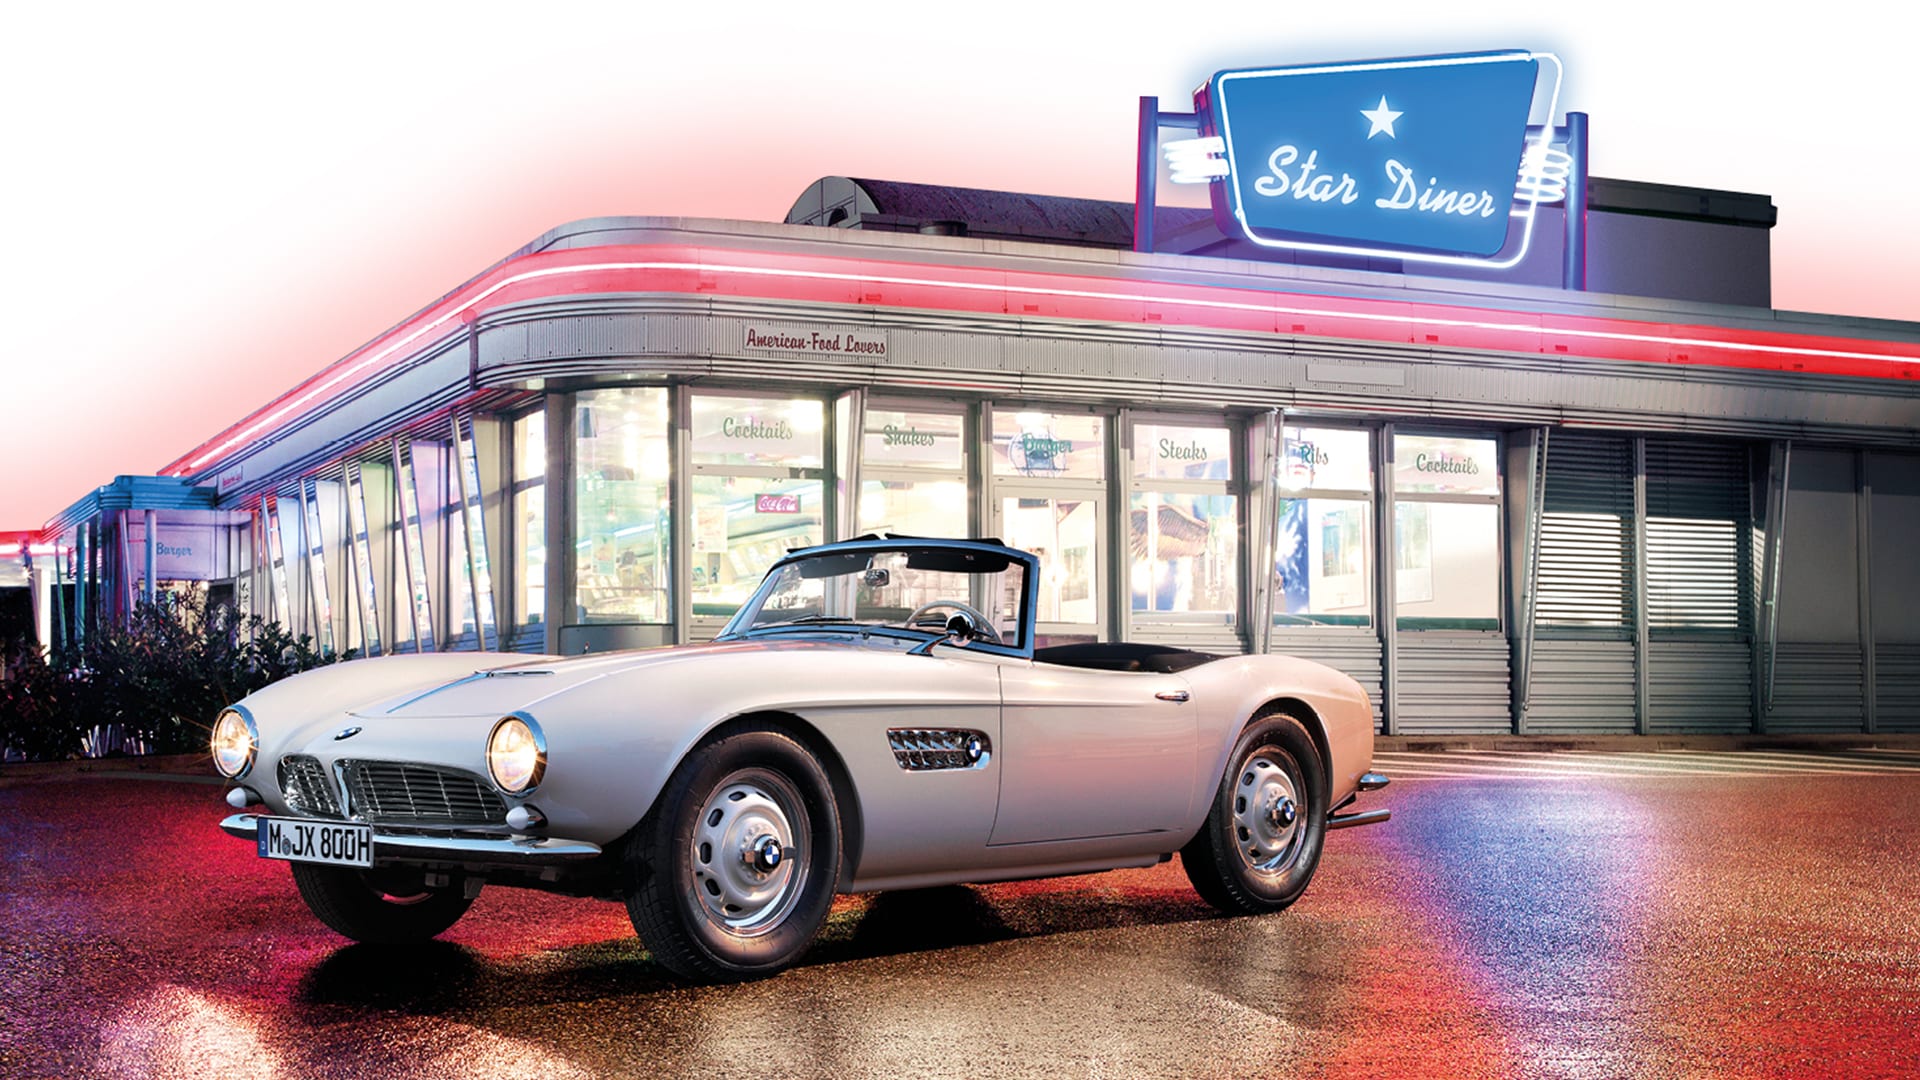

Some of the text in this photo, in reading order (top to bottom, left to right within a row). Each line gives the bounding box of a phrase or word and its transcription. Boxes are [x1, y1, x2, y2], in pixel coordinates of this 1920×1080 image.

[1254, 144, 1496, 218] Star Diner
[746, 328, 886, 354] American-Food Lovers
[722, 416, 793, 440] Cocktails
[883, 424, 935, 447] Shakes
[1021, 432, 1074, 457] Burger
[1158, 438, 1208, 461] Steaks
[1299, 445, 1329, 466] Ribs
[1416, 453, 1479, 475] Cocktails
[156, 542, 193, 558] Burger
[269, 823, 370, 862] M JX 800H
